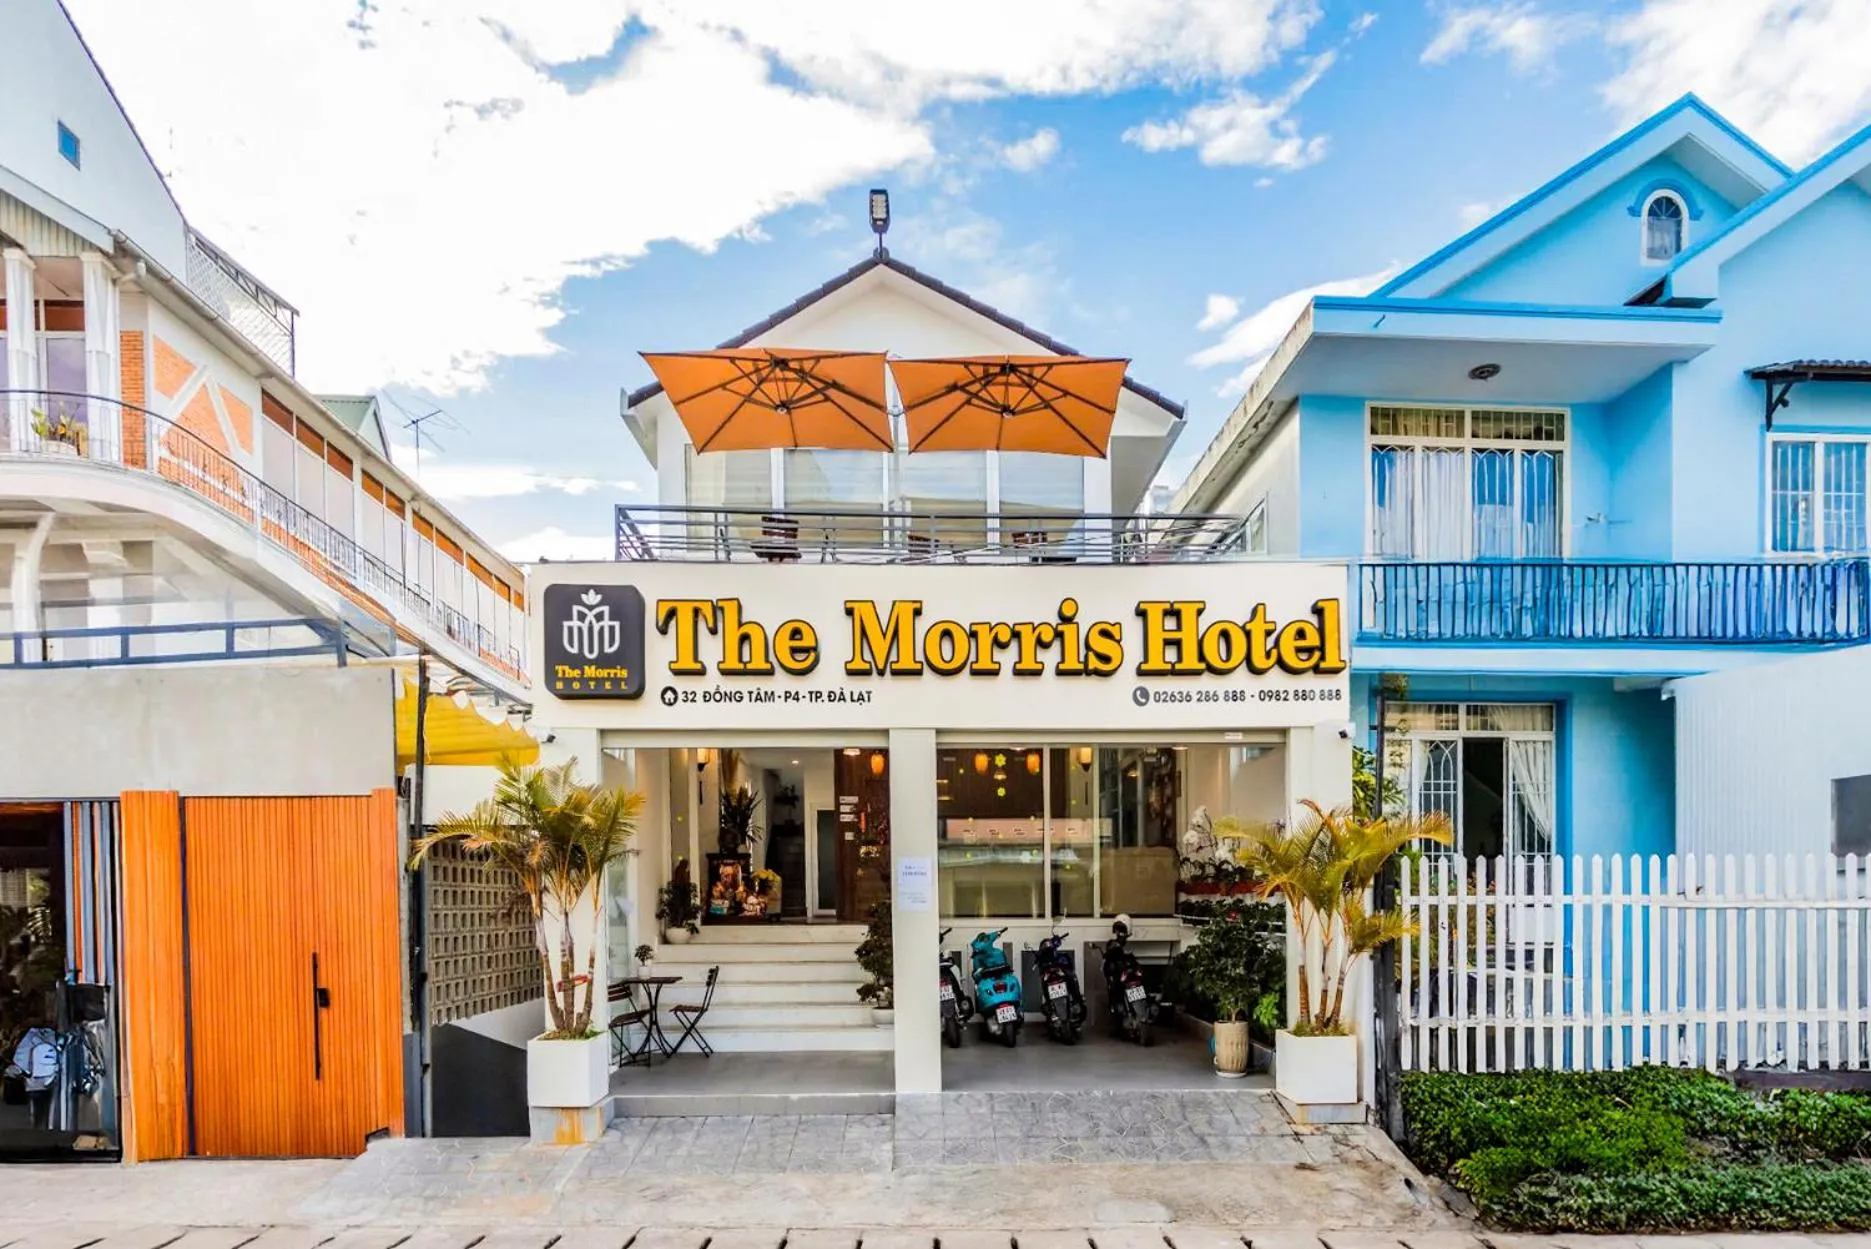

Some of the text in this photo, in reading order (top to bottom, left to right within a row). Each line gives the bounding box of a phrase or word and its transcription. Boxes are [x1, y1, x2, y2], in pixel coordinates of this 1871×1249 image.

[656, 598, 1347, 677] The Morris Hotel
[555, 664, 628, 679] The Morris
[555, 681, 628, 690] HOTEL
[681, 690, 697, 703] 32
[827, 687, 846, 703] ĐÀ
[850, 690, 872, 706] LẠT
[1153, 690, 1192, 703] 02636
[1196, 690, 1219, 703] 286
[1224, 689, 1246, 702] 888
[1258, 689, 1289, 702] 0982
[1293, 689, 1316, 702] 880
[1319, 689, 1342, 702] 888
